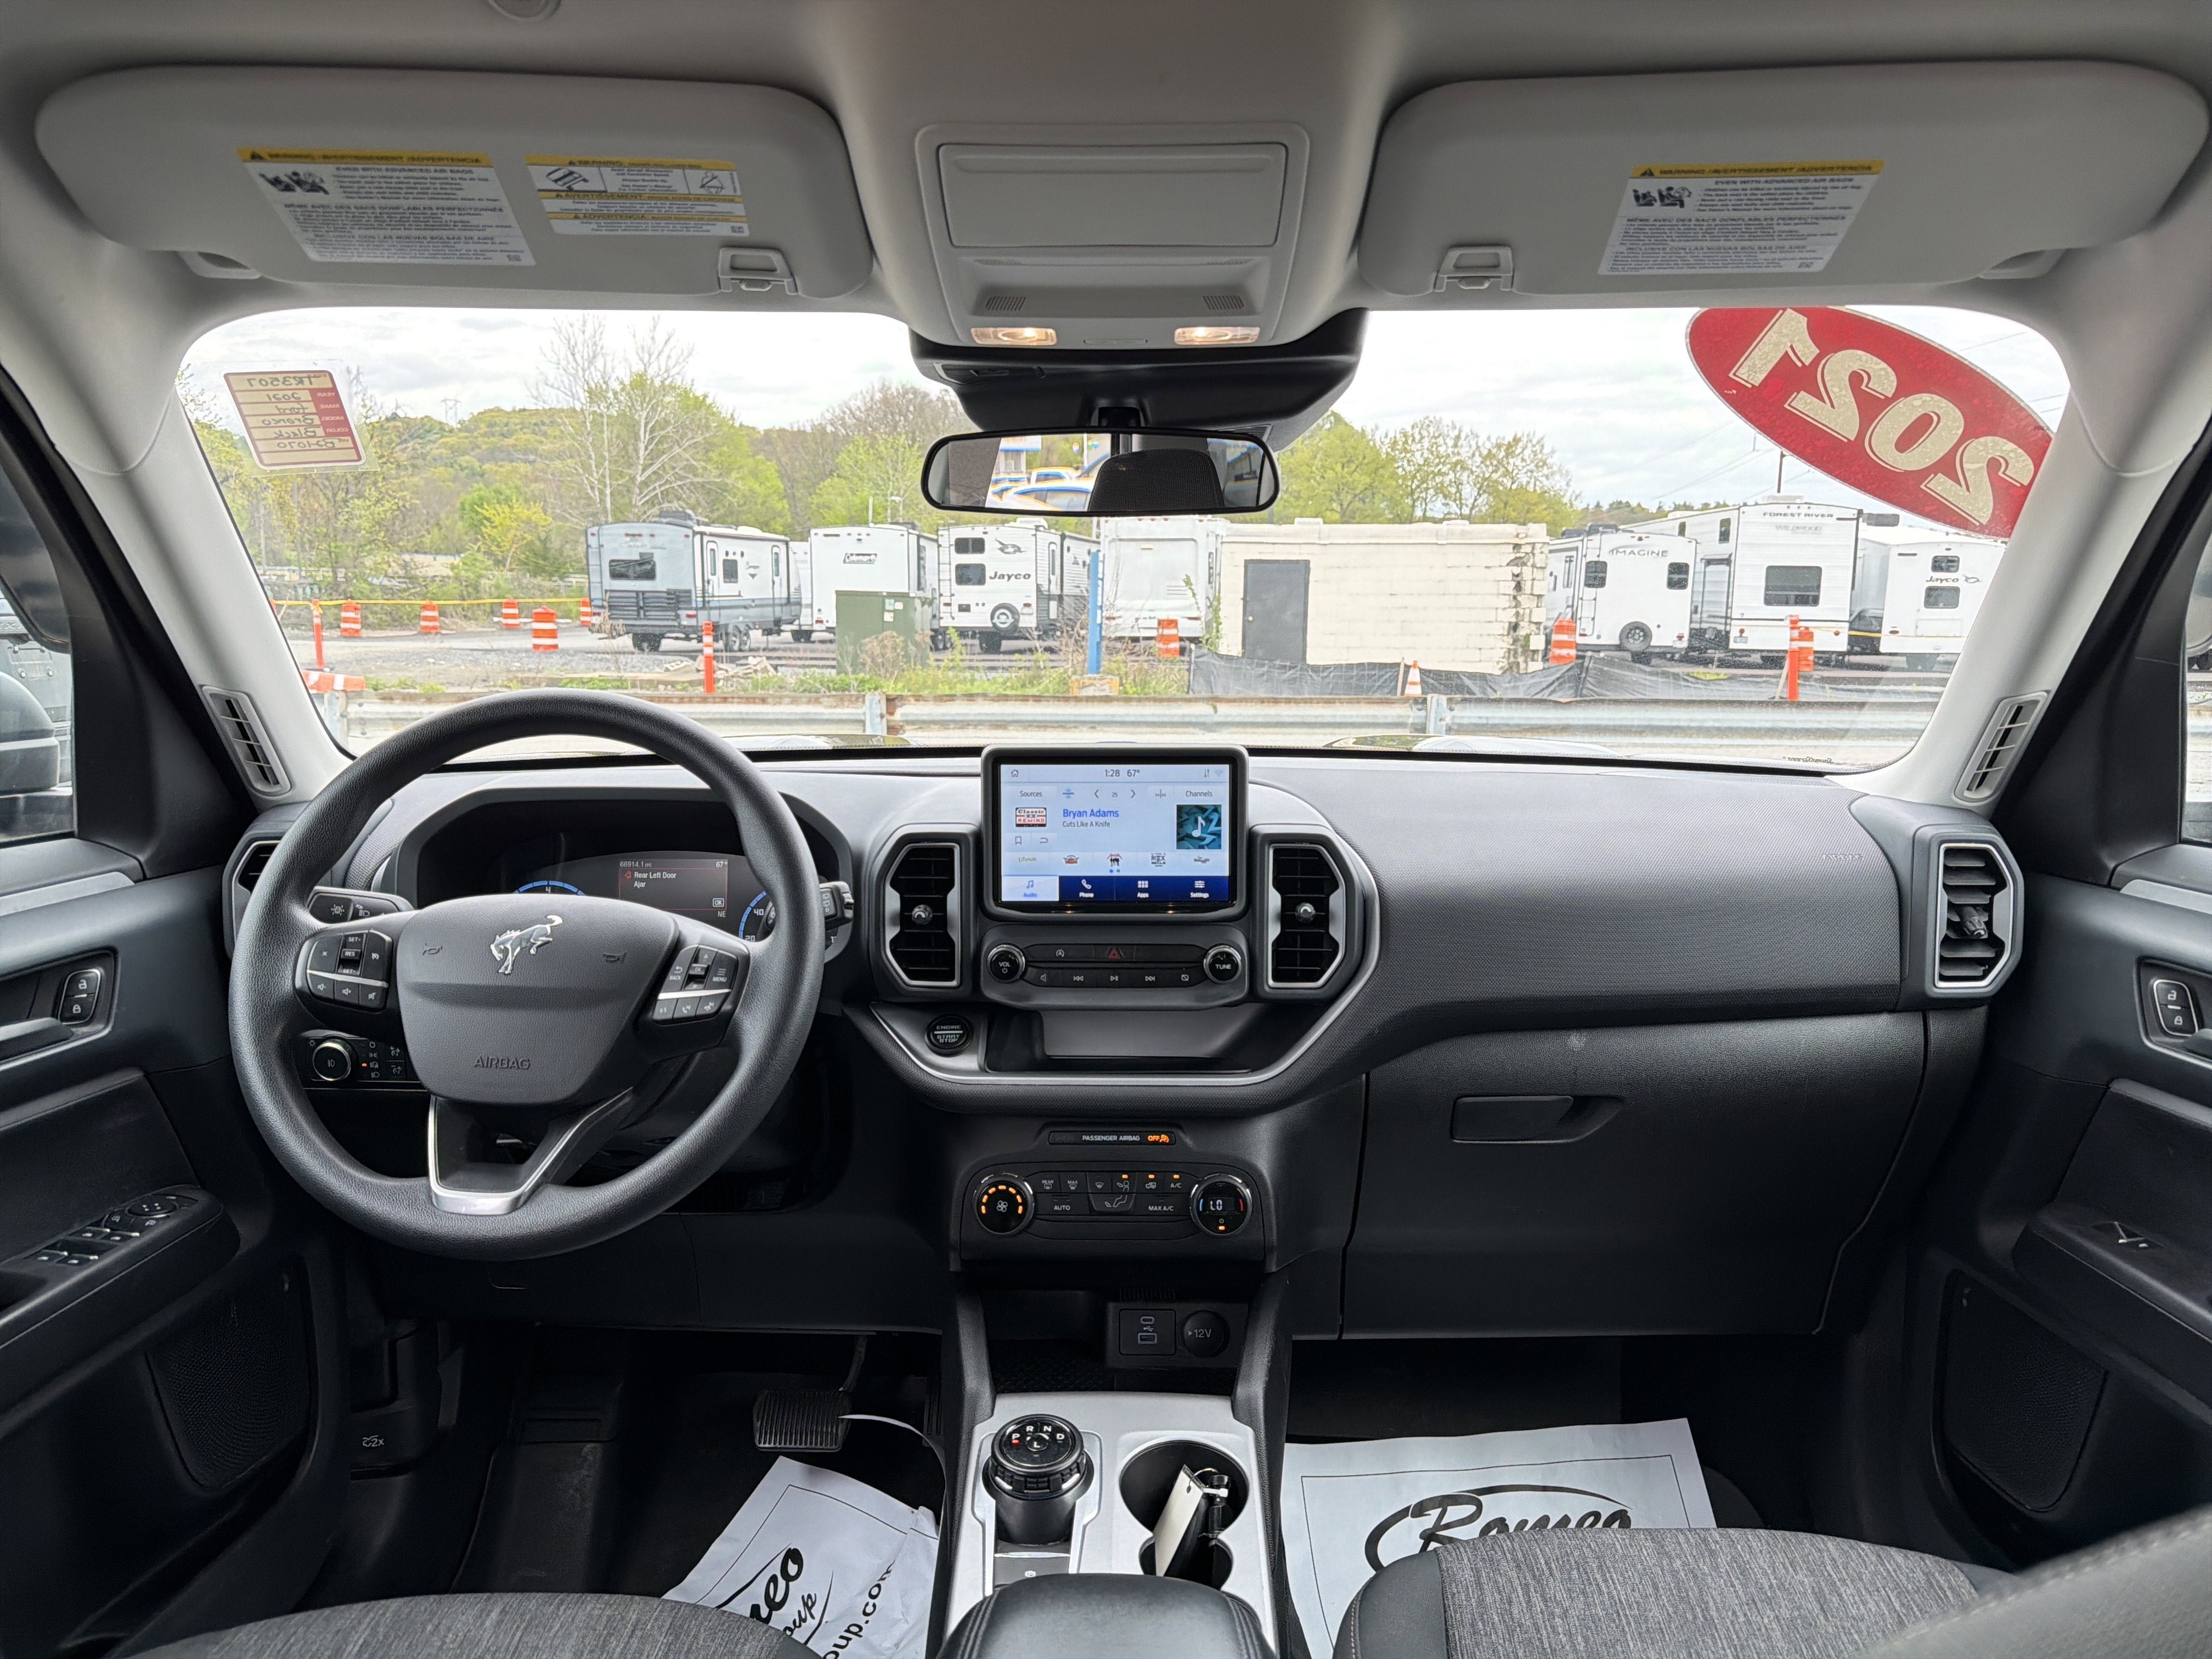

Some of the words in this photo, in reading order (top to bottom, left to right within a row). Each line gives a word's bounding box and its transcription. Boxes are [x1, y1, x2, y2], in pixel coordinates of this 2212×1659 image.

[1609, 549, 1668, 557] IMAGINE
[989, 571, 1031, 583] Jayco
[1926, 575, 1959, 584] Jayco
[1104, 769, 1120, 777] 1:28
[1127, 769, 1141, 777] 67°
[1062, 809, 1087, 819] Bryan
[1089, 808, 1119, 818] Adams
[633, 881, 646, 889] Ajar
[474, 1055, 531, 1070] AIRBAG
[1193, 1328, 1212, 1338] 12V
